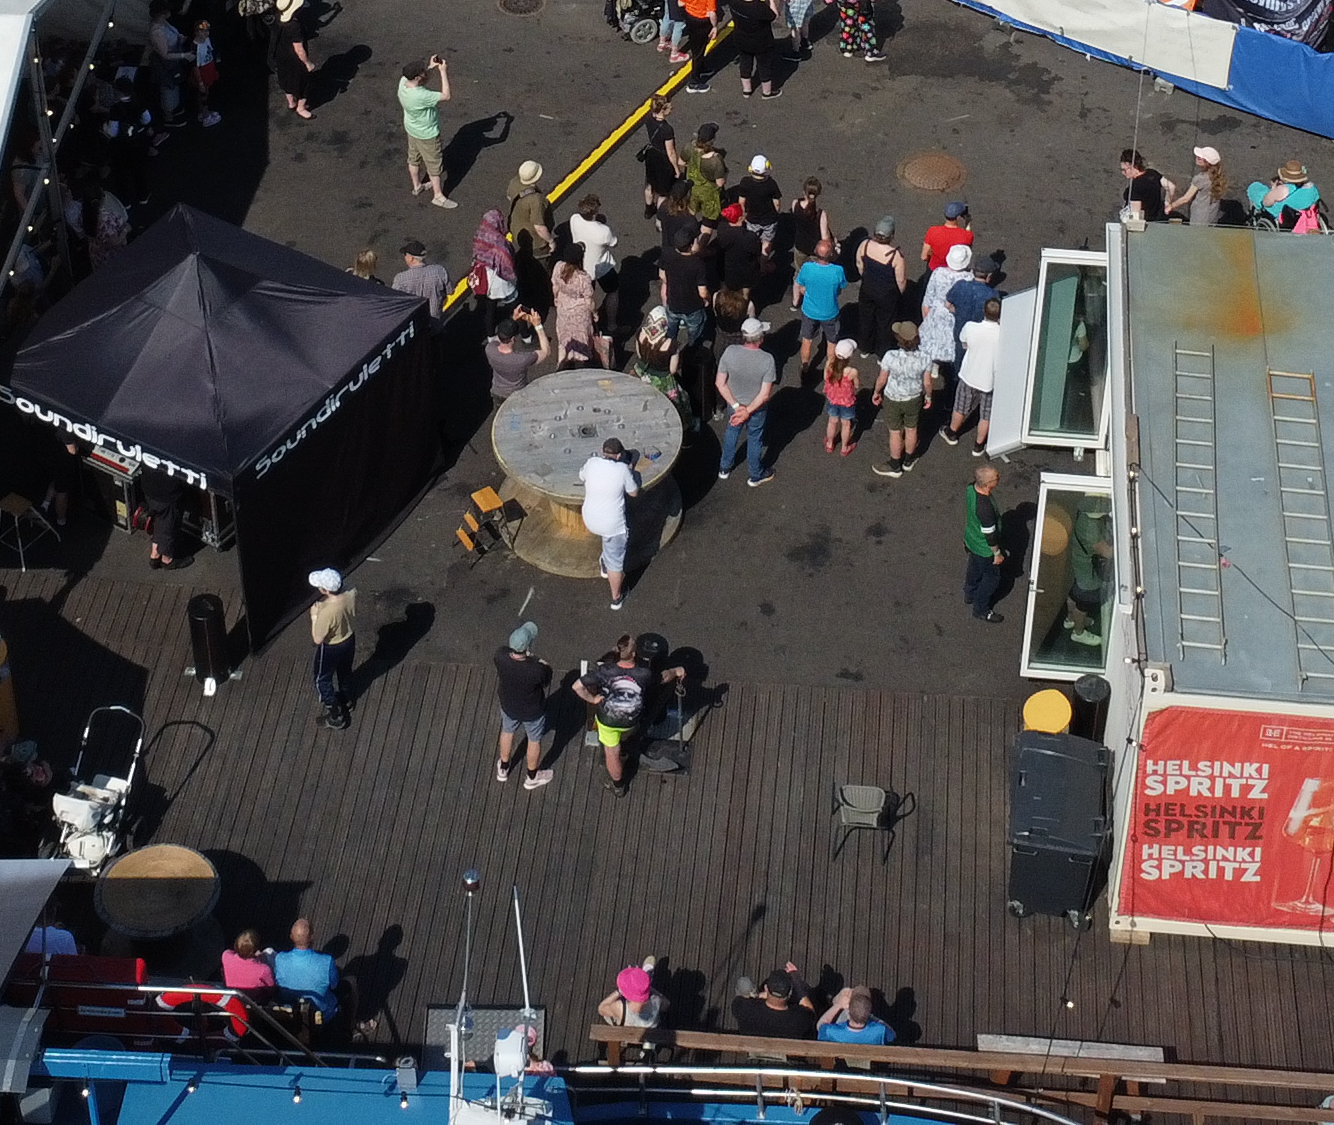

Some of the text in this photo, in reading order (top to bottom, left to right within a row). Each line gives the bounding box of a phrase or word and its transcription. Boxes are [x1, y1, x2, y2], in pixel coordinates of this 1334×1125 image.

[254, 320, 415, 480] Soundiruletti
[1146, 759, 1269, 779] HELSINKI
[1144, 775, 1269, 799] SPRITZ
[1144, 802, 1265, 820] HELSINKI
[1143, 818, 1263, 841] SPRITZ
[1142, 844, 1262, 862] HELSINKI
[1140, 859, 1262, 882] SPRITZ
